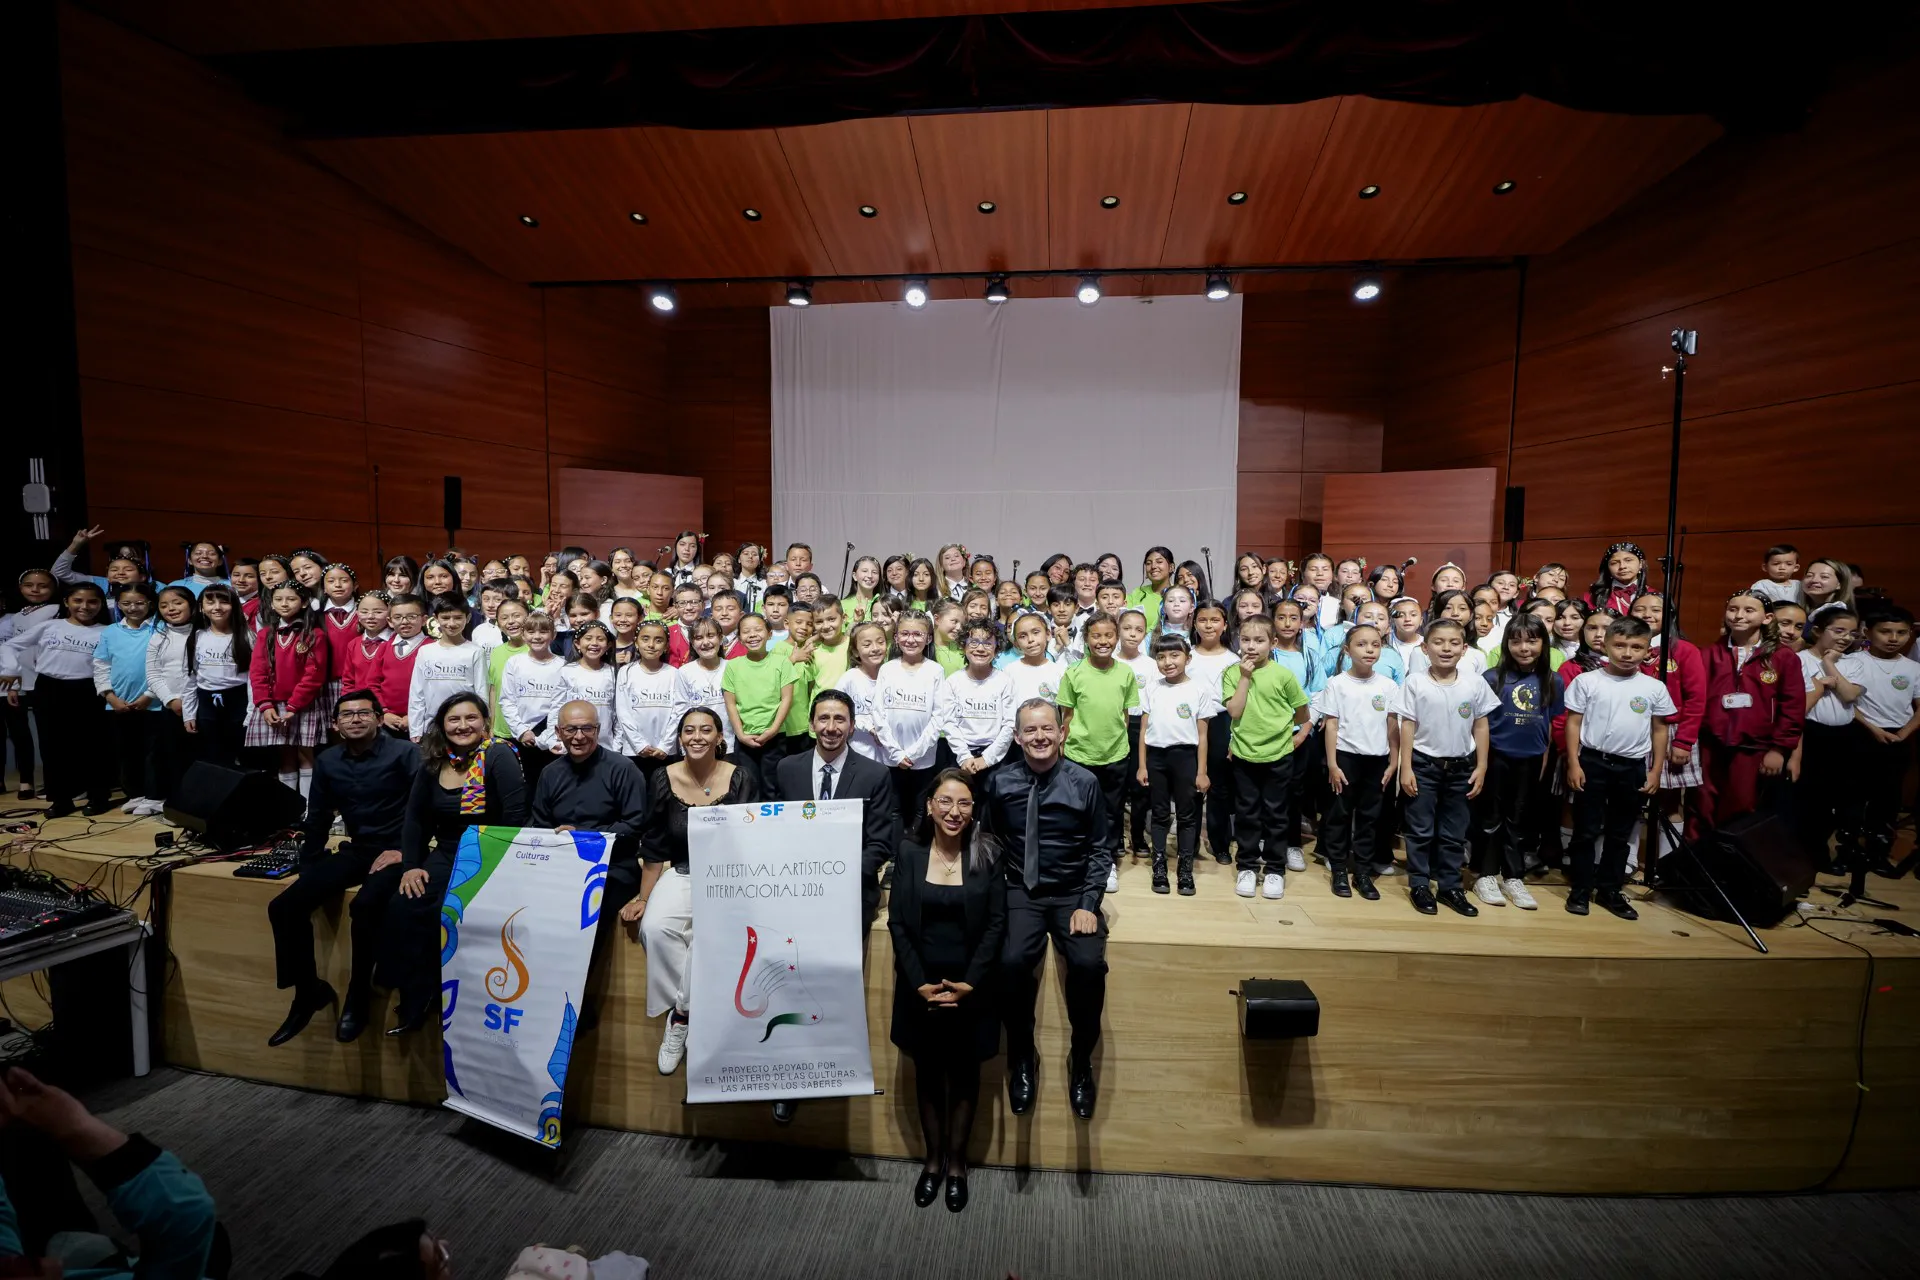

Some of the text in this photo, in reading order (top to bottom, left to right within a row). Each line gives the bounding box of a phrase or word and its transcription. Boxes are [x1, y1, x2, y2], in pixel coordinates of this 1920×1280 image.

[62, 634, 100, 650] Suasi
[434, 661, 467, 674] Suasi
[585, 686, 611, 699] Suas
[640, 688, 671, 701] Suasi
[895, 687, 926, 703] Suasi
[964, 697, 997, 711] Suasi
[760, 803, 784, 816] SF
[702, 815, 727, 823] Culturas
[515, 850, 550, 861] Culturas
[726, 862, 776, 877] FESTIVAL
[779, 860, 846, 876] ARTÍSTICO
[706, 882, 824, 899] INTERNACIONAL 2026
[484, 1003, 524, 1034] SF
[721, 1061, 836, 1074] PROYECTO APOYADO POR
[704, 1069, 858, 1084] EL MINISTERIO DE LAS CULTURAS,
[720, 1079, 843, 1093] LAS ARTES Y LOS SABERES
